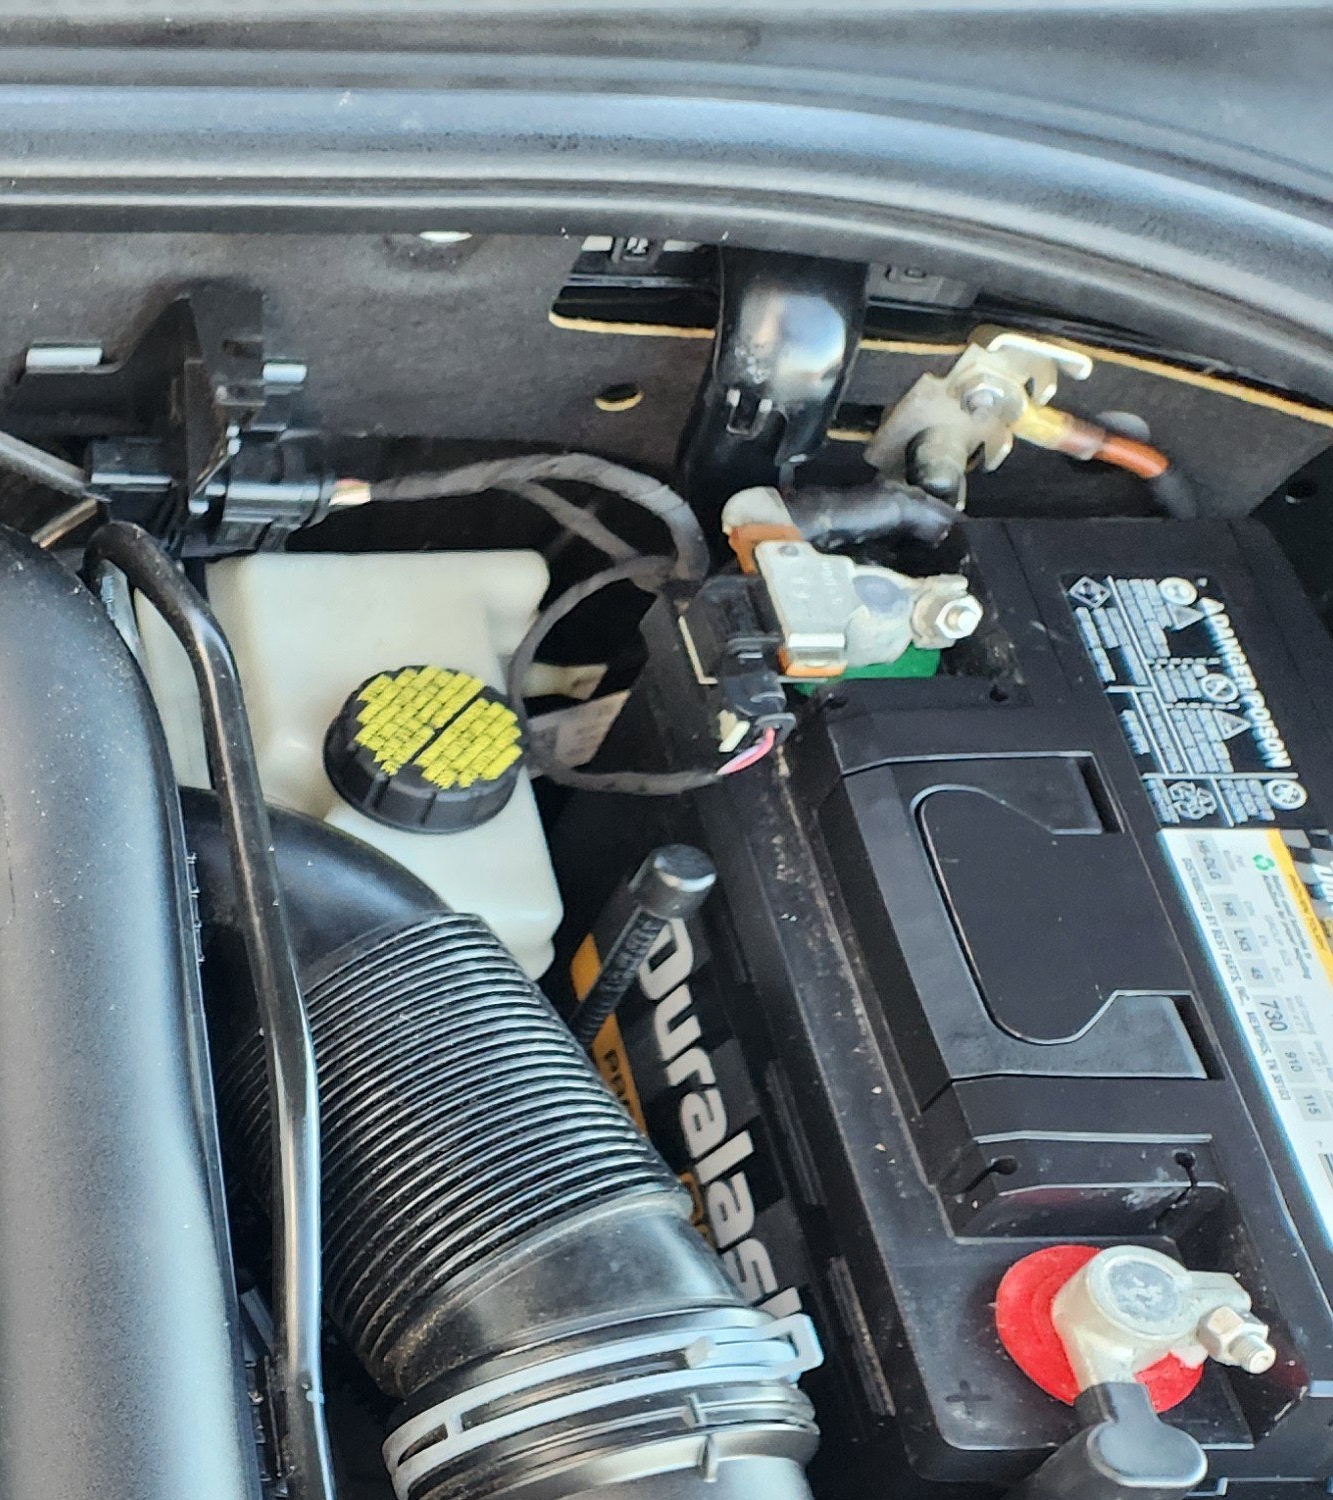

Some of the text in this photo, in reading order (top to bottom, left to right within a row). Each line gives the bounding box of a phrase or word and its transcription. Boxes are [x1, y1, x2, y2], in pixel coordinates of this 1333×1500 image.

[1259, 999, 1289, 1033] 730
[1284, 1050, 1304, 1073] 910
[1303, 1094, 1322, 1116] 115
